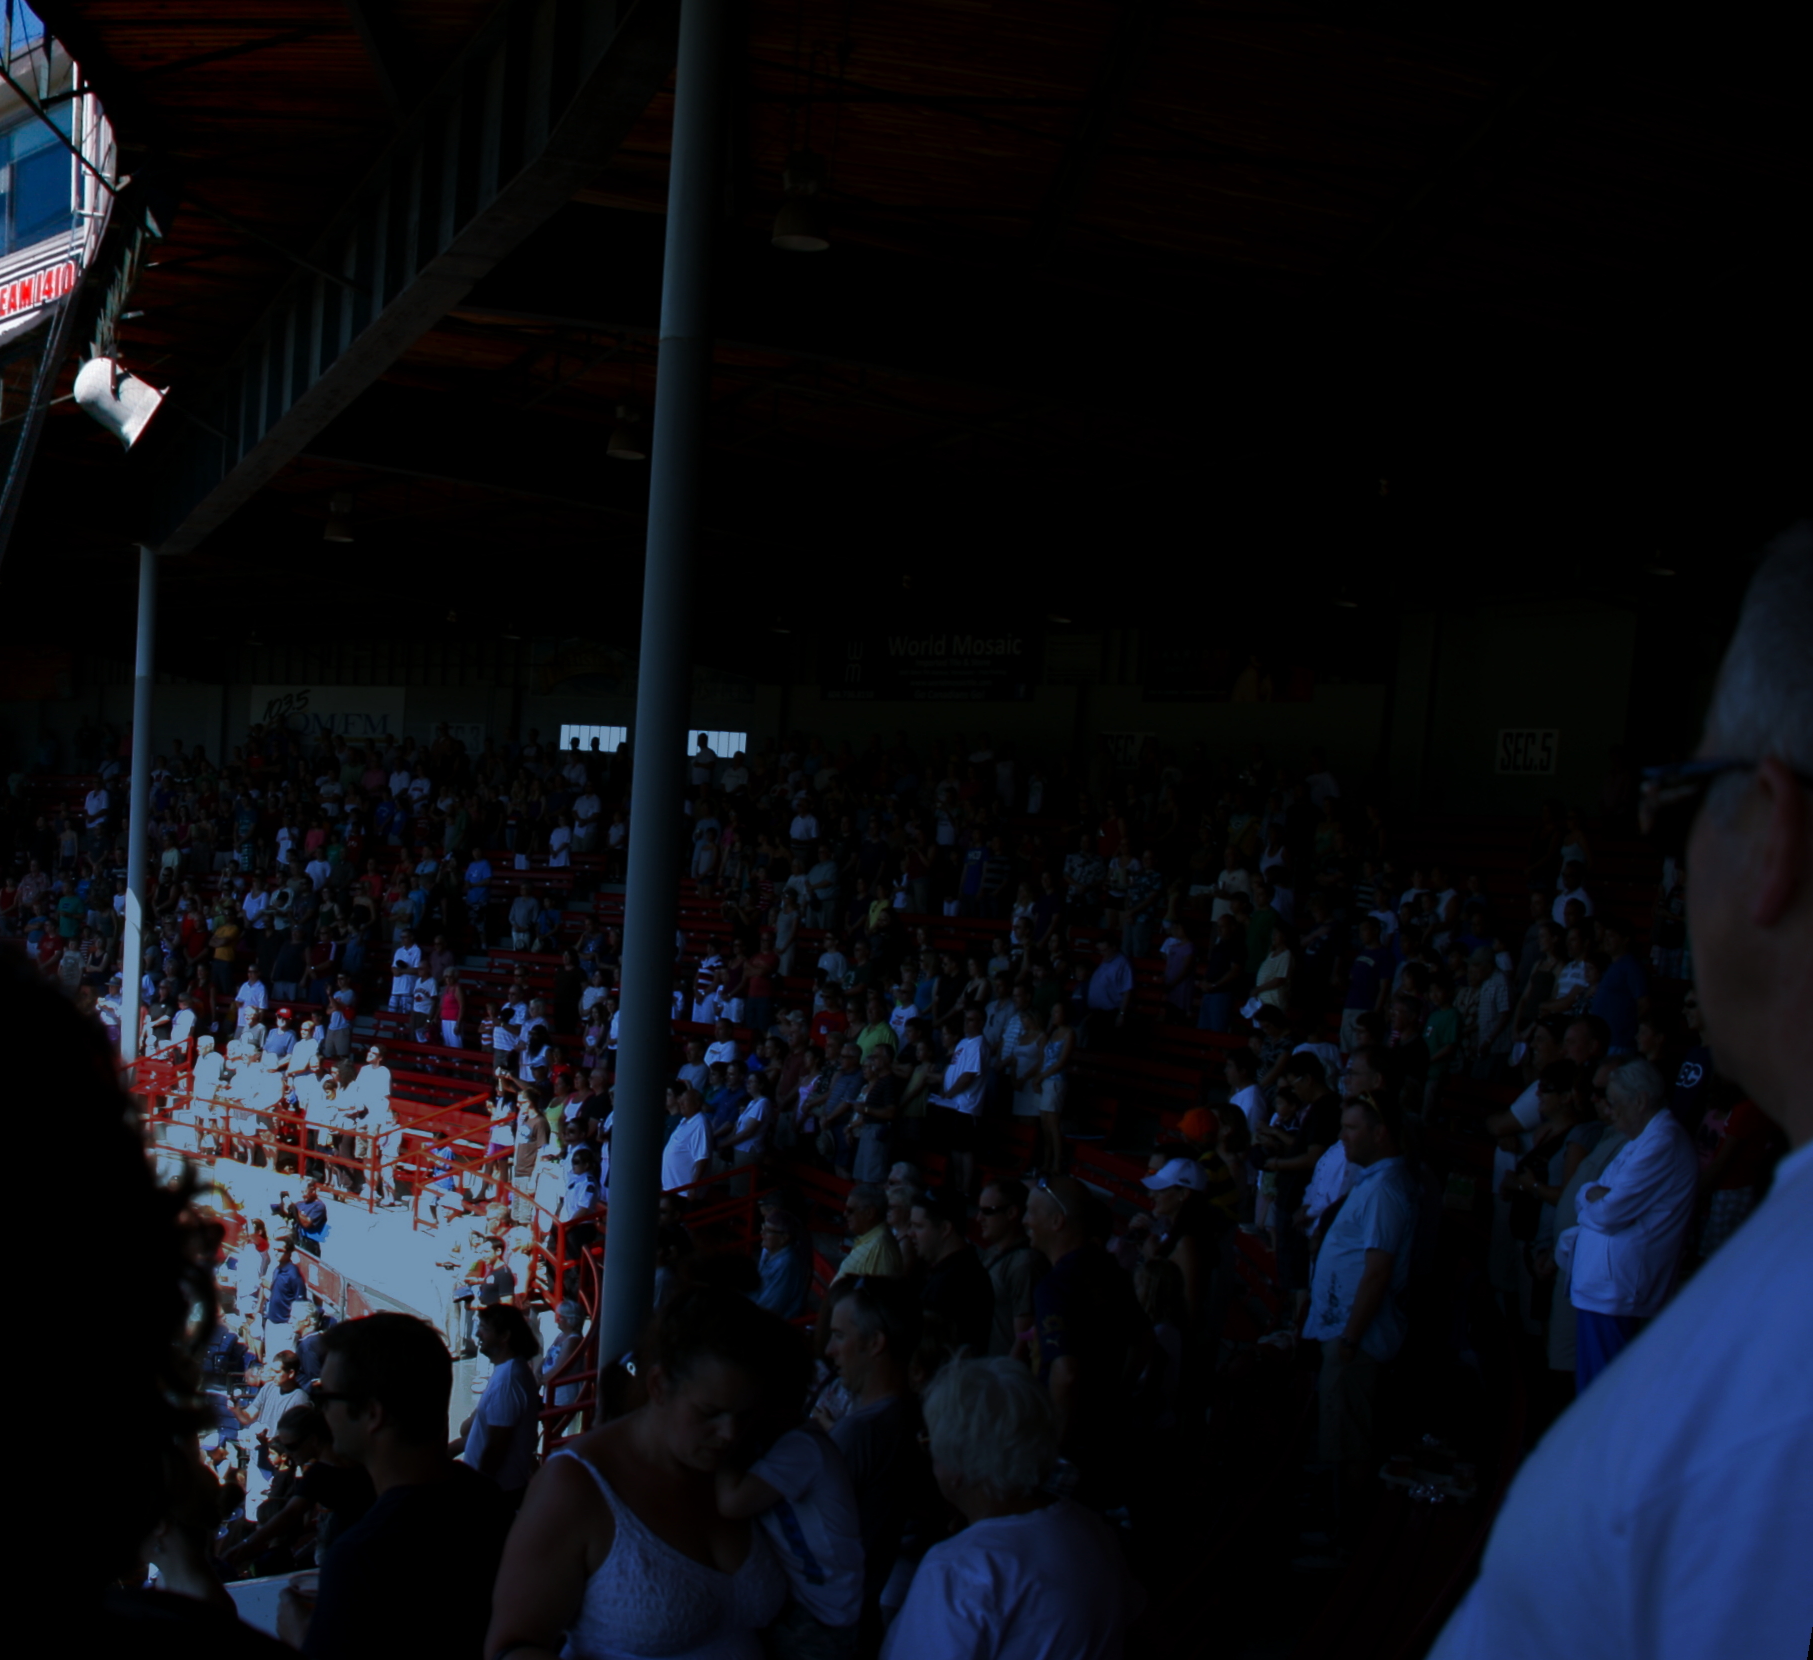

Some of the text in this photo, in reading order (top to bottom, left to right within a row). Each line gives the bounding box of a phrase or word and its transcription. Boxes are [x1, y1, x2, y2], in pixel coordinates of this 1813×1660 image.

[887, 632, 1023, 657] World Mosaic
[1500, 732, 1554, 771] SEC.5
